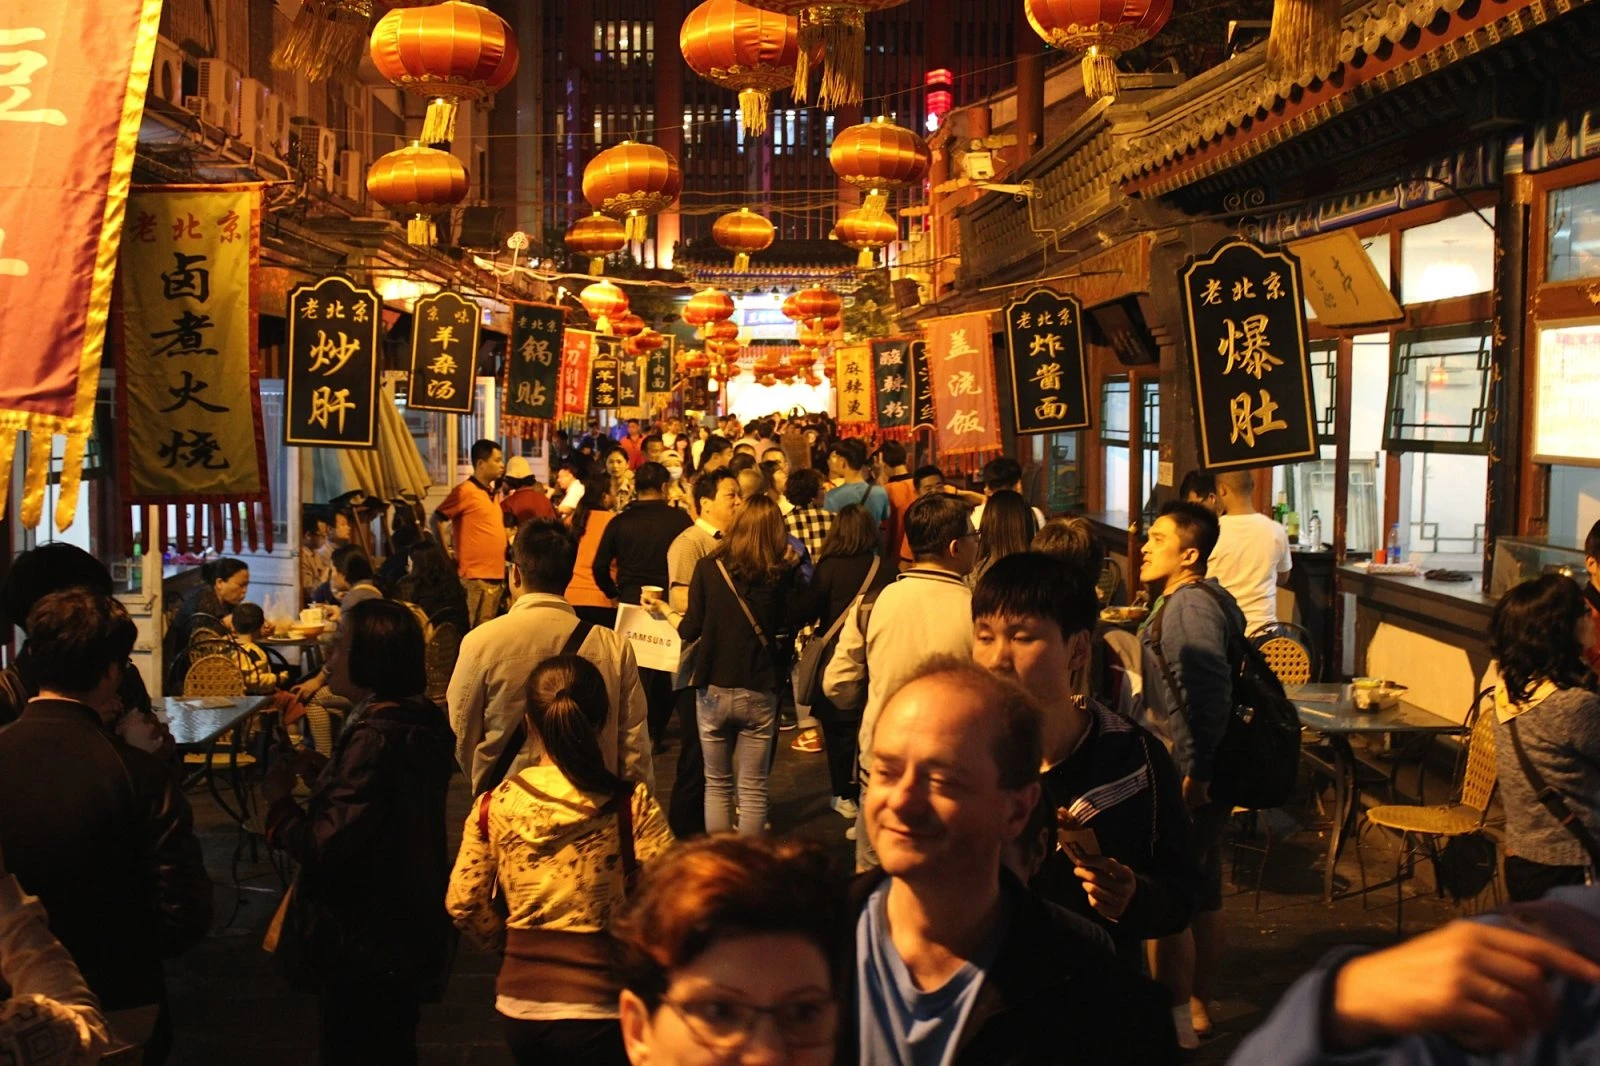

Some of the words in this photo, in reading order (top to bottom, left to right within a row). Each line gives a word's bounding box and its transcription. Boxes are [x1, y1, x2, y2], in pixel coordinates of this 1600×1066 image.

[130, 210, 243, 244] 老北京
[300, 297, 370, 322] 老北京
[425, 306, 470, 324] 京味
[1199, 271, 1286, 307] 老北京
[517, 316, 557, 333] 老北京
[1016, 306, 1073, 330] 老北京
[150, 252, 231, 470] 卤煮火烧
[307, 330, 361, 434] 炒肝
[427, 326, 460, 400] 羊杂汤
[843, 361, 865, 416] 麻辣烫
[880, 348, 909, 418] 酸辣粉
[944, 328, 986, 435] 盖浇饭
[1028, 333, 1068, 420] 炸酱面
[1217, 313, 1289, 448] 爆肚
[626, 631, 672, 647] SAMSUNG
